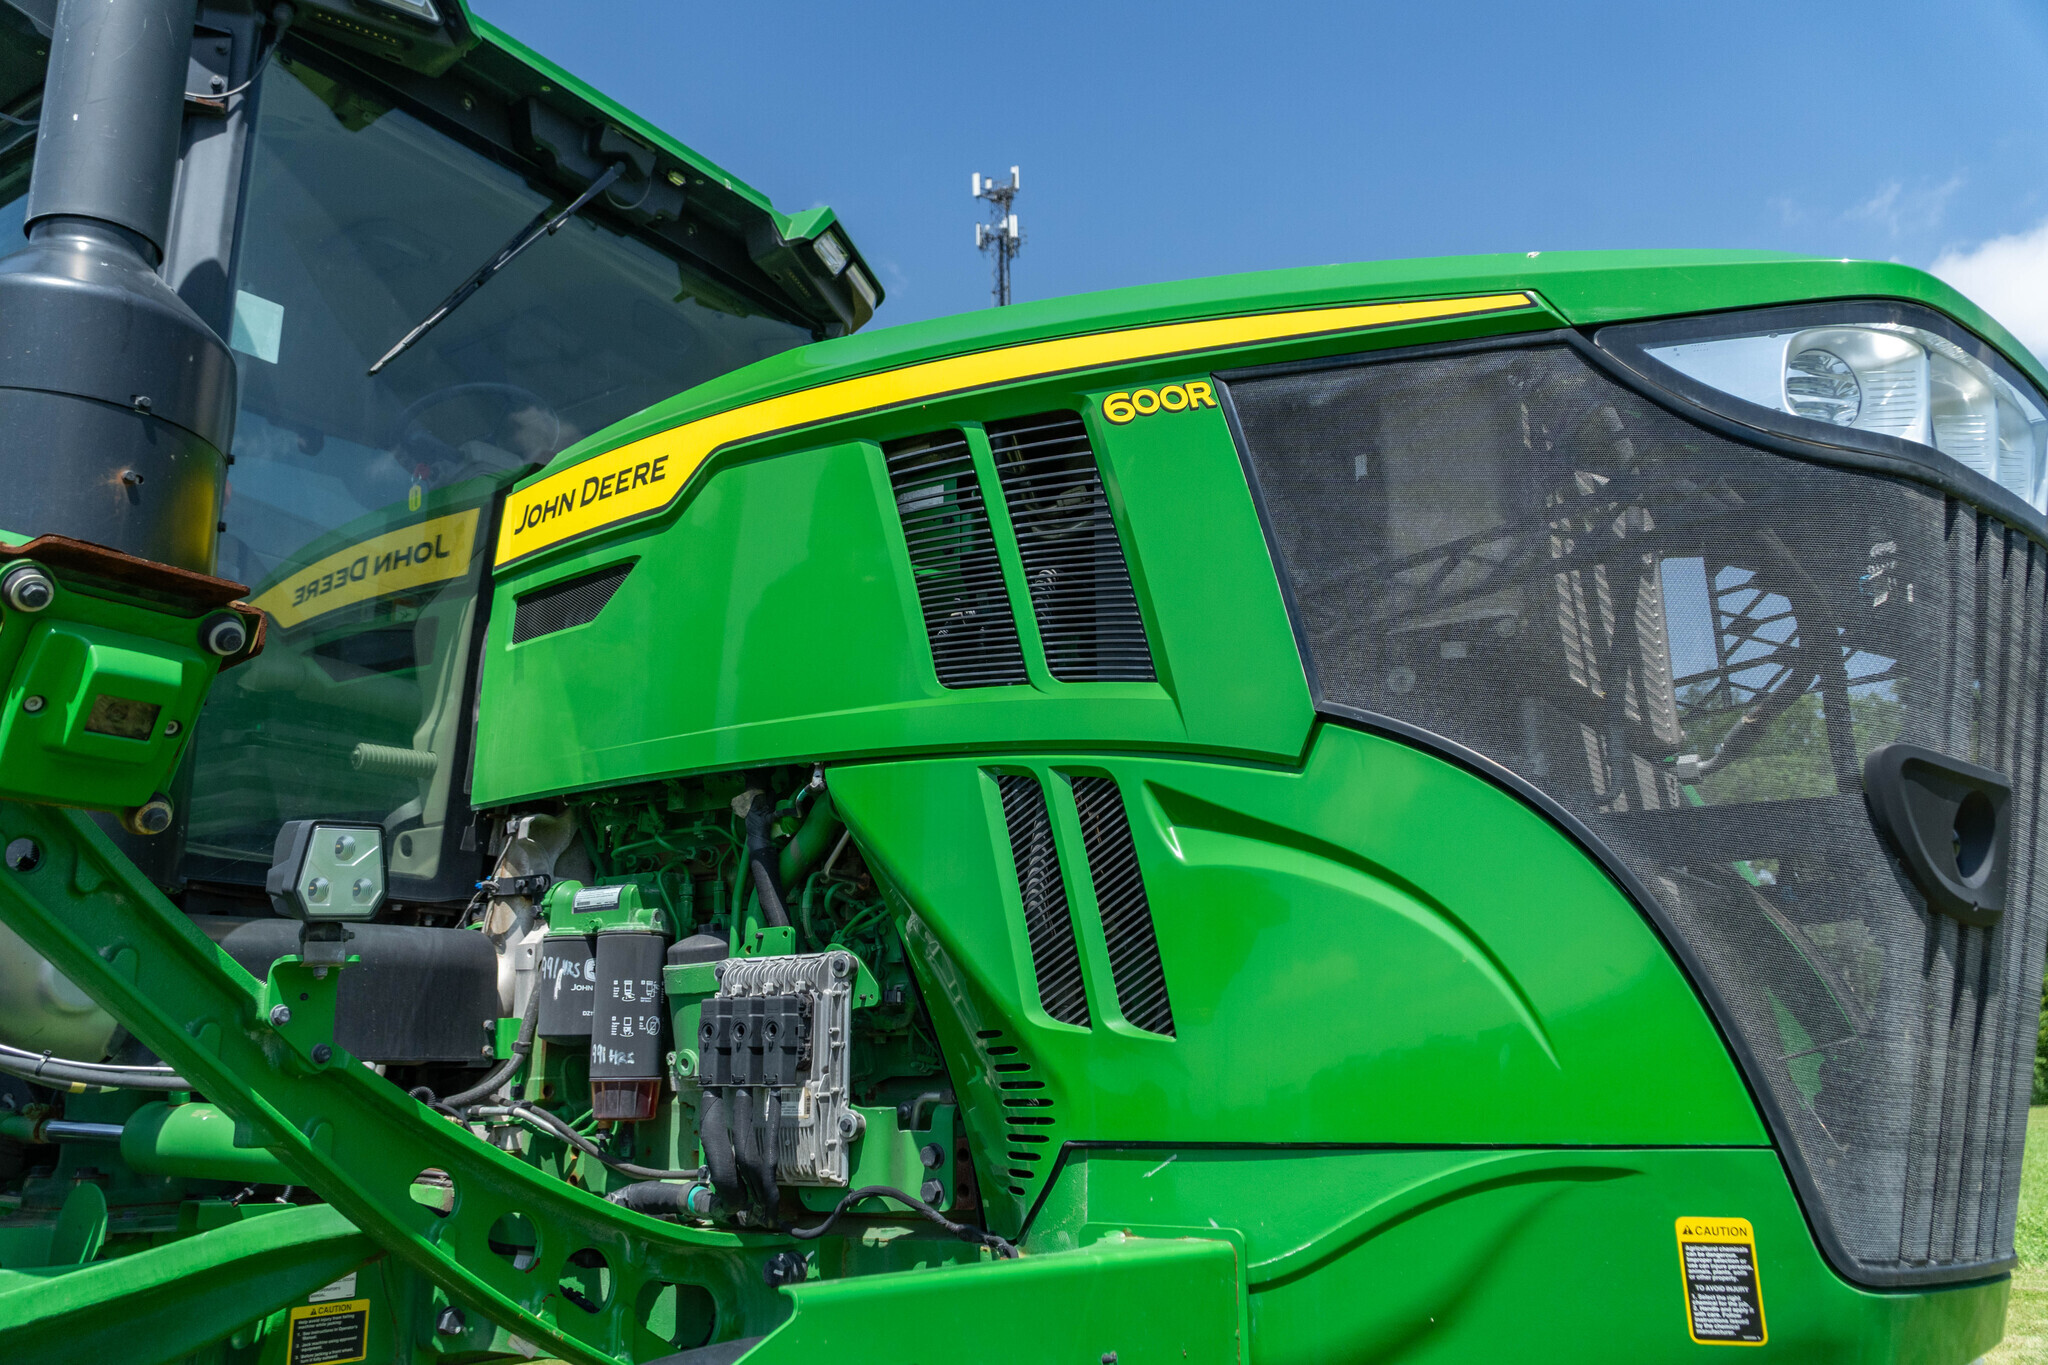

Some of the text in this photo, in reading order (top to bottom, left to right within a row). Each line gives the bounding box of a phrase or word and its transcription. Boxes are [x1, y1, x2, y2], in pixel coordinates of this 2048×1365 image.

[1102, 381, 1217, 426] 600R
[514, 454, 669, 535] JOHN DEERE
[1695, 1226, 1747, 1236] CAUTION
[318, 1304, 352, 1314] CAUTION
